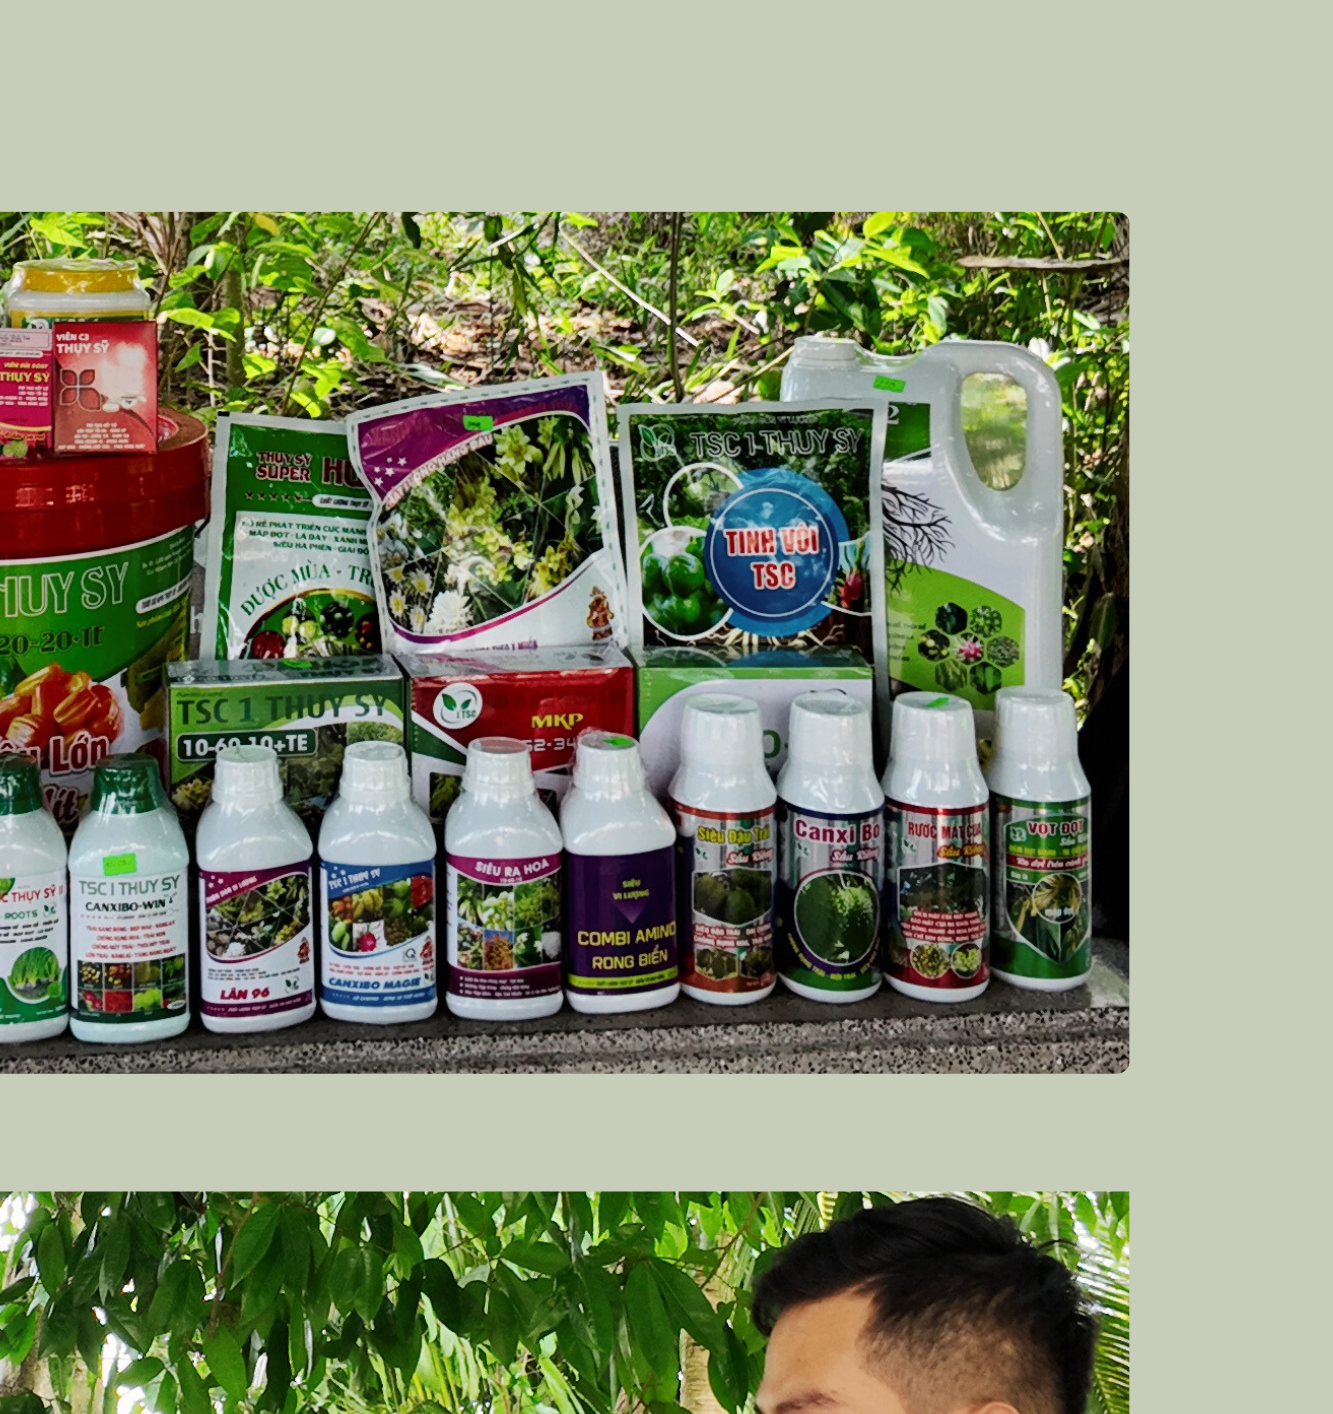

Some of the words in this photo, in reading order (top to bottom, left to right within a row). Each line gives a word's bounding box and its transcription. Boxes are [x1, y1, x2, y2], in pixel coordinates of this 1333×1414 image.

[690, 431, 741, 457] TSC
[760, 428, 830, 456] THUY
[834, 427, 864, 453] SY
[256, 464, 312, 483] SUPER
[726, 527, 775, 556] TINH
[778, 523, 819, 554] VÔI
[80, 561, 130, 610] SY
[751, 562, 795, 590] TSC
[176, 698, 229, 726] TSC
[269, 693, 349, 722] THUY
[354, 693, 385, 717] SY
[531, 712, 584, 730] MKP
[49, 732, 111, 777] Lớn
[795, 818, 855, 845] Canxi
[908, 822, 938, 838] RƯỚC
[1027, 820, 1056, 838] VỌT
[1061, 819, 1084, 837] ĐỌT
[474, 861, 501, 876] SIÊU
[505, 867, 521, 878] RA
[523, 858, 550, 875] HOA
[79, 880, 107, 896] TSC
[118, 878, 159, 896] THUY
[161, 874, 181, 892] SY
[4, 910, 38, 920] ROOTS
[85, 898, 166, 912] CANXIBO-WIN
[577, 929, 631, 947] COMBI
[635, 919, 677, 943] AMINO
[592, 953, 634, 970] RONG
[638, 944, 668, 967] BIỂN
[220, 986, 248, 1001] LÂN
[252, 987, 271, 999] 96
[329, 977, 380, 990] CANXIBO
[383, 977, 422, 990] MAGIE
